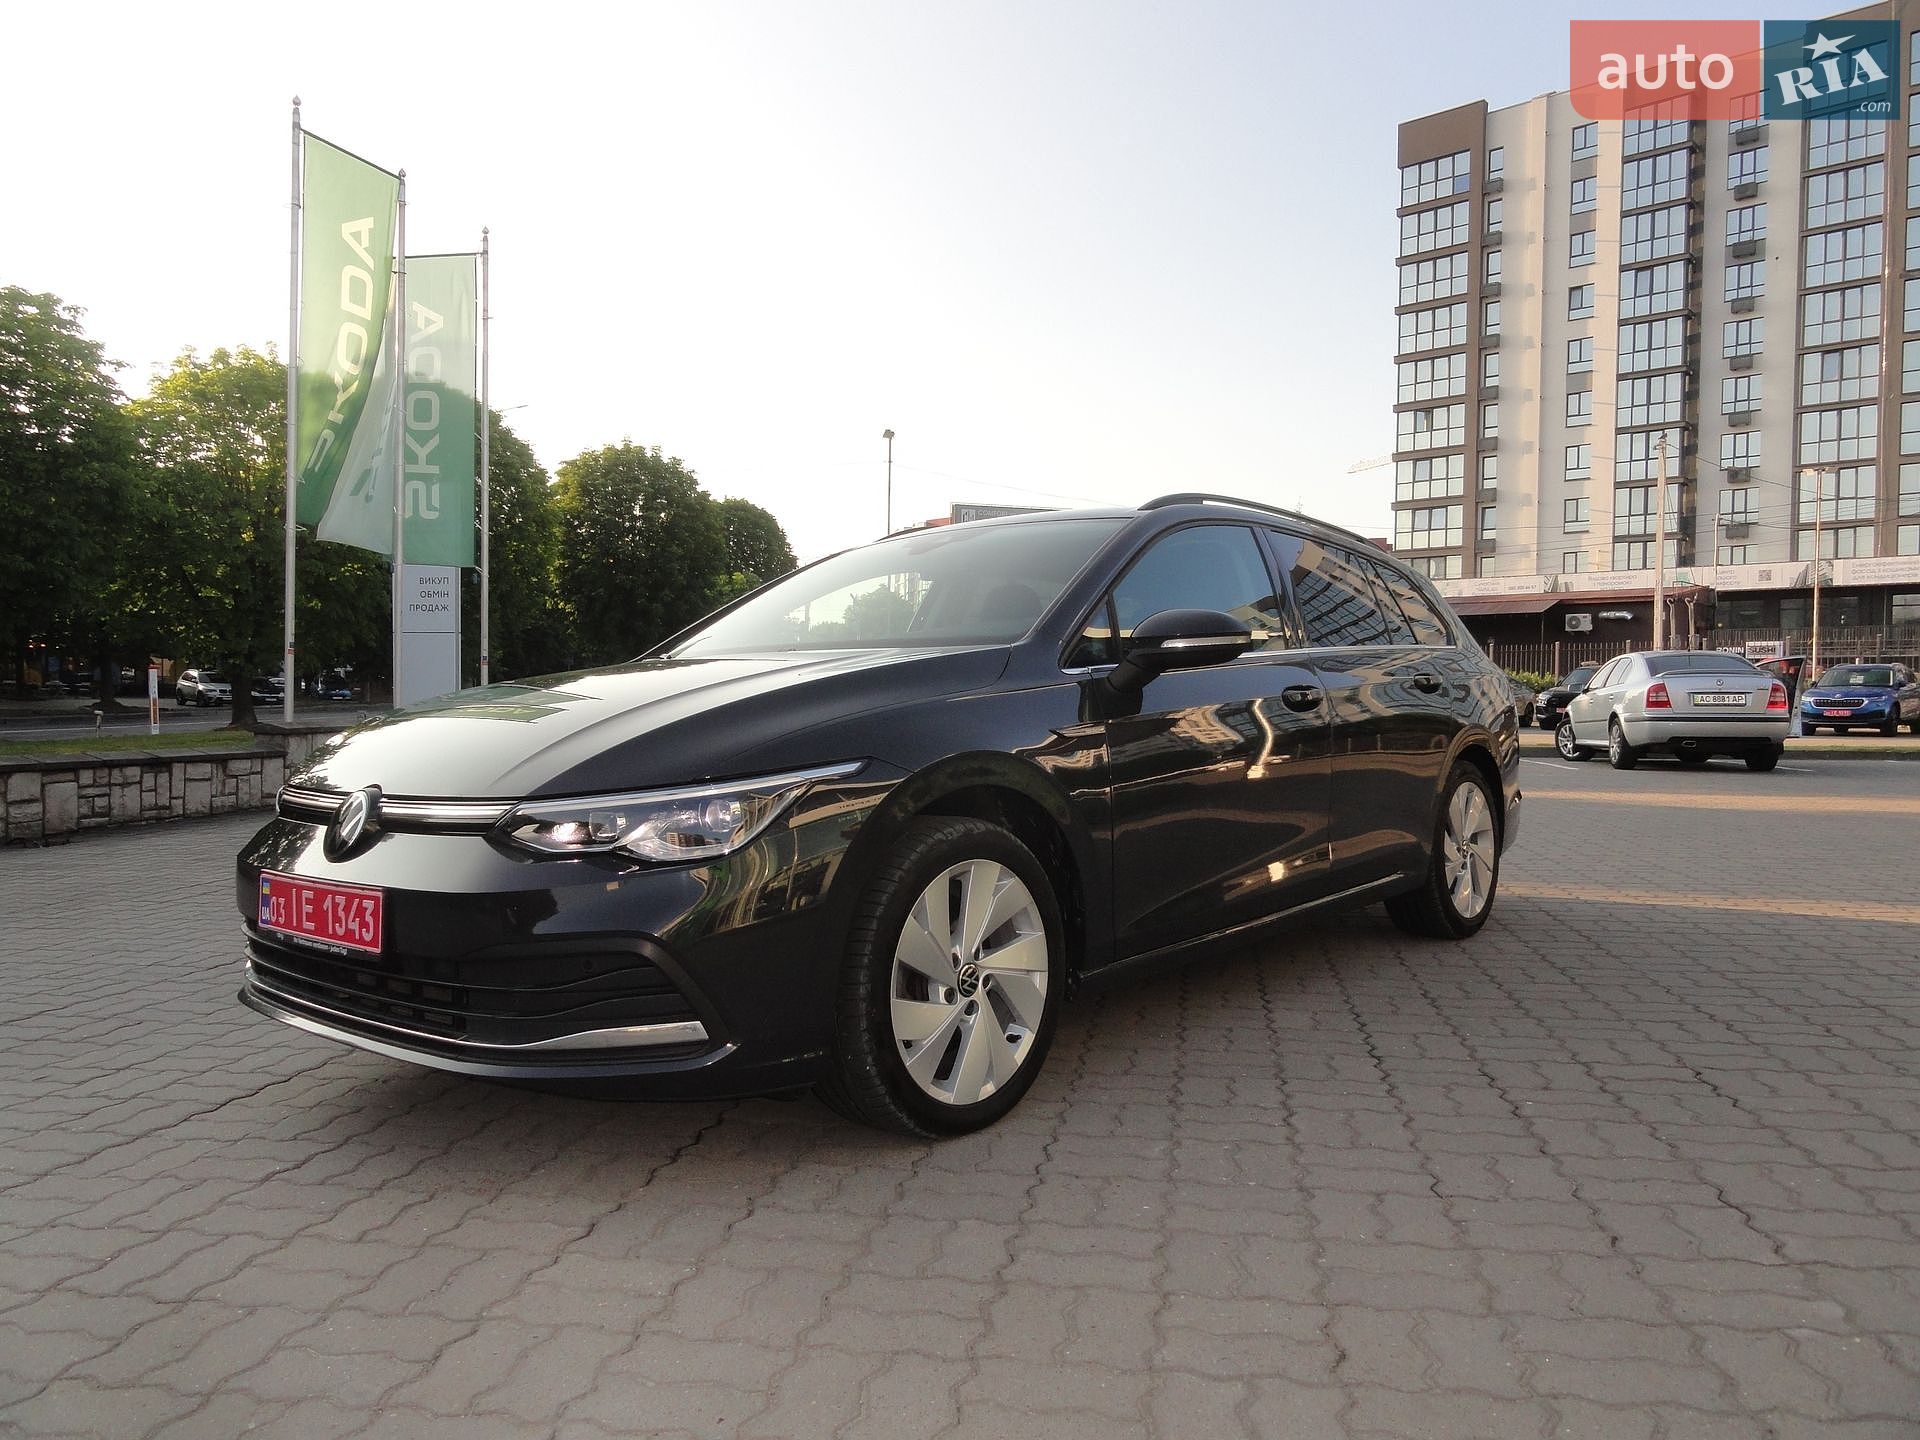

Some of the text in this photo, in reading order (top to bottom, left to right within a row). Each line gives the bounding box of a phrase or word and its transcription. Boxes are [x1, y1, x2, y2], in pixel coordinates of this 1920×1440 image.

[419, 576, 449, 585] ВИКУП
[419, 590, 449, 599] ОБМІН
[409, 603, 449, 613] ПРОДАЖ
[270, 895, 286, 925] 03
[291, 888, 316, 931] IE
[322, 893, 375, 942] 1343
